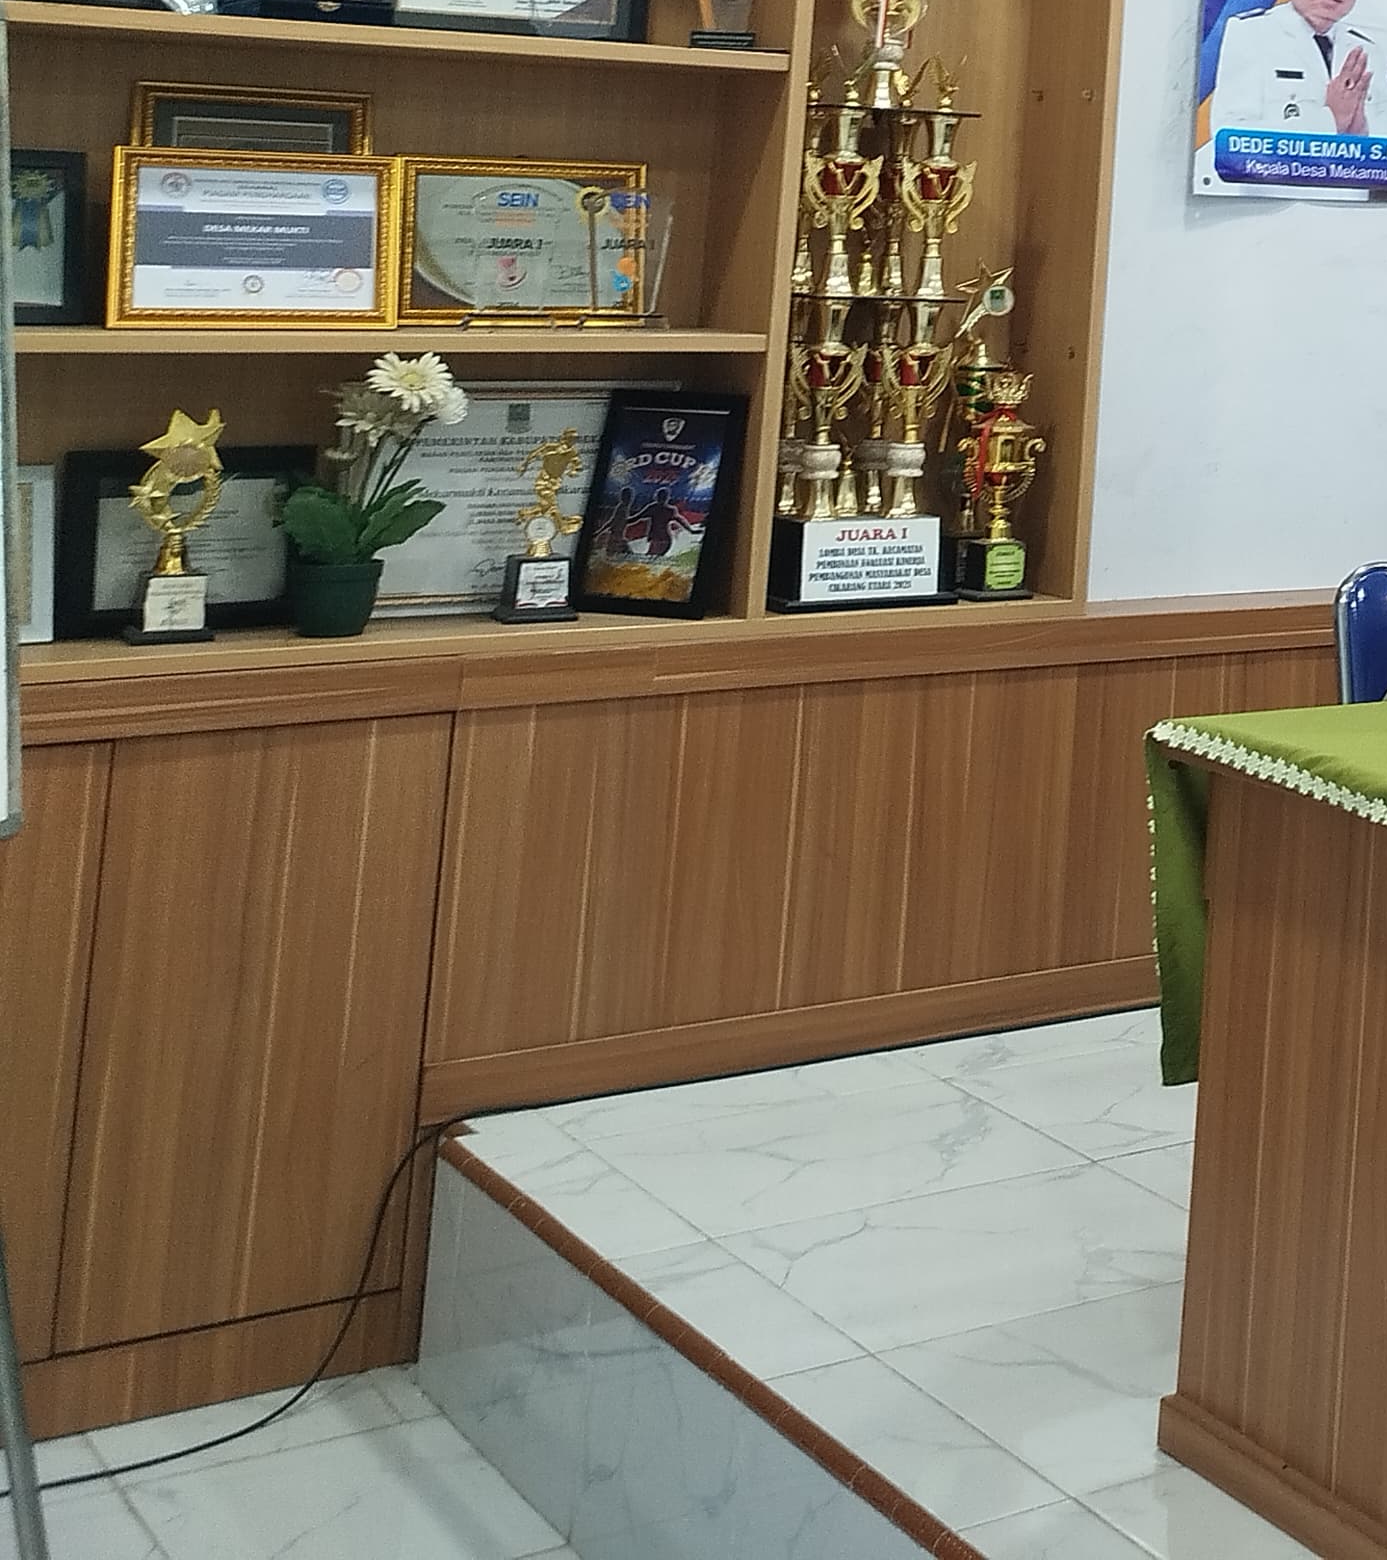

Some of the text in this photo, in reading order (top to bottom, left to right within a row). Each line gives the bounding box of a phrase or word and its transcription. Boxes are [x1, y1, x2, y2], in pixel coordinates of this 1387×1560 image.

[1229, 136, 1273, 154] DEDE
[1277, 139, 1366, 161] SULEMAN,
[1245, 160, 1289, 178] Kepala
[1291, 162, 1326, 177] Desa
[498, 192, 539, 207] SEIN
[655, 451, 696, 468] CUP
[835, 528, 908, 541] JUARA I
